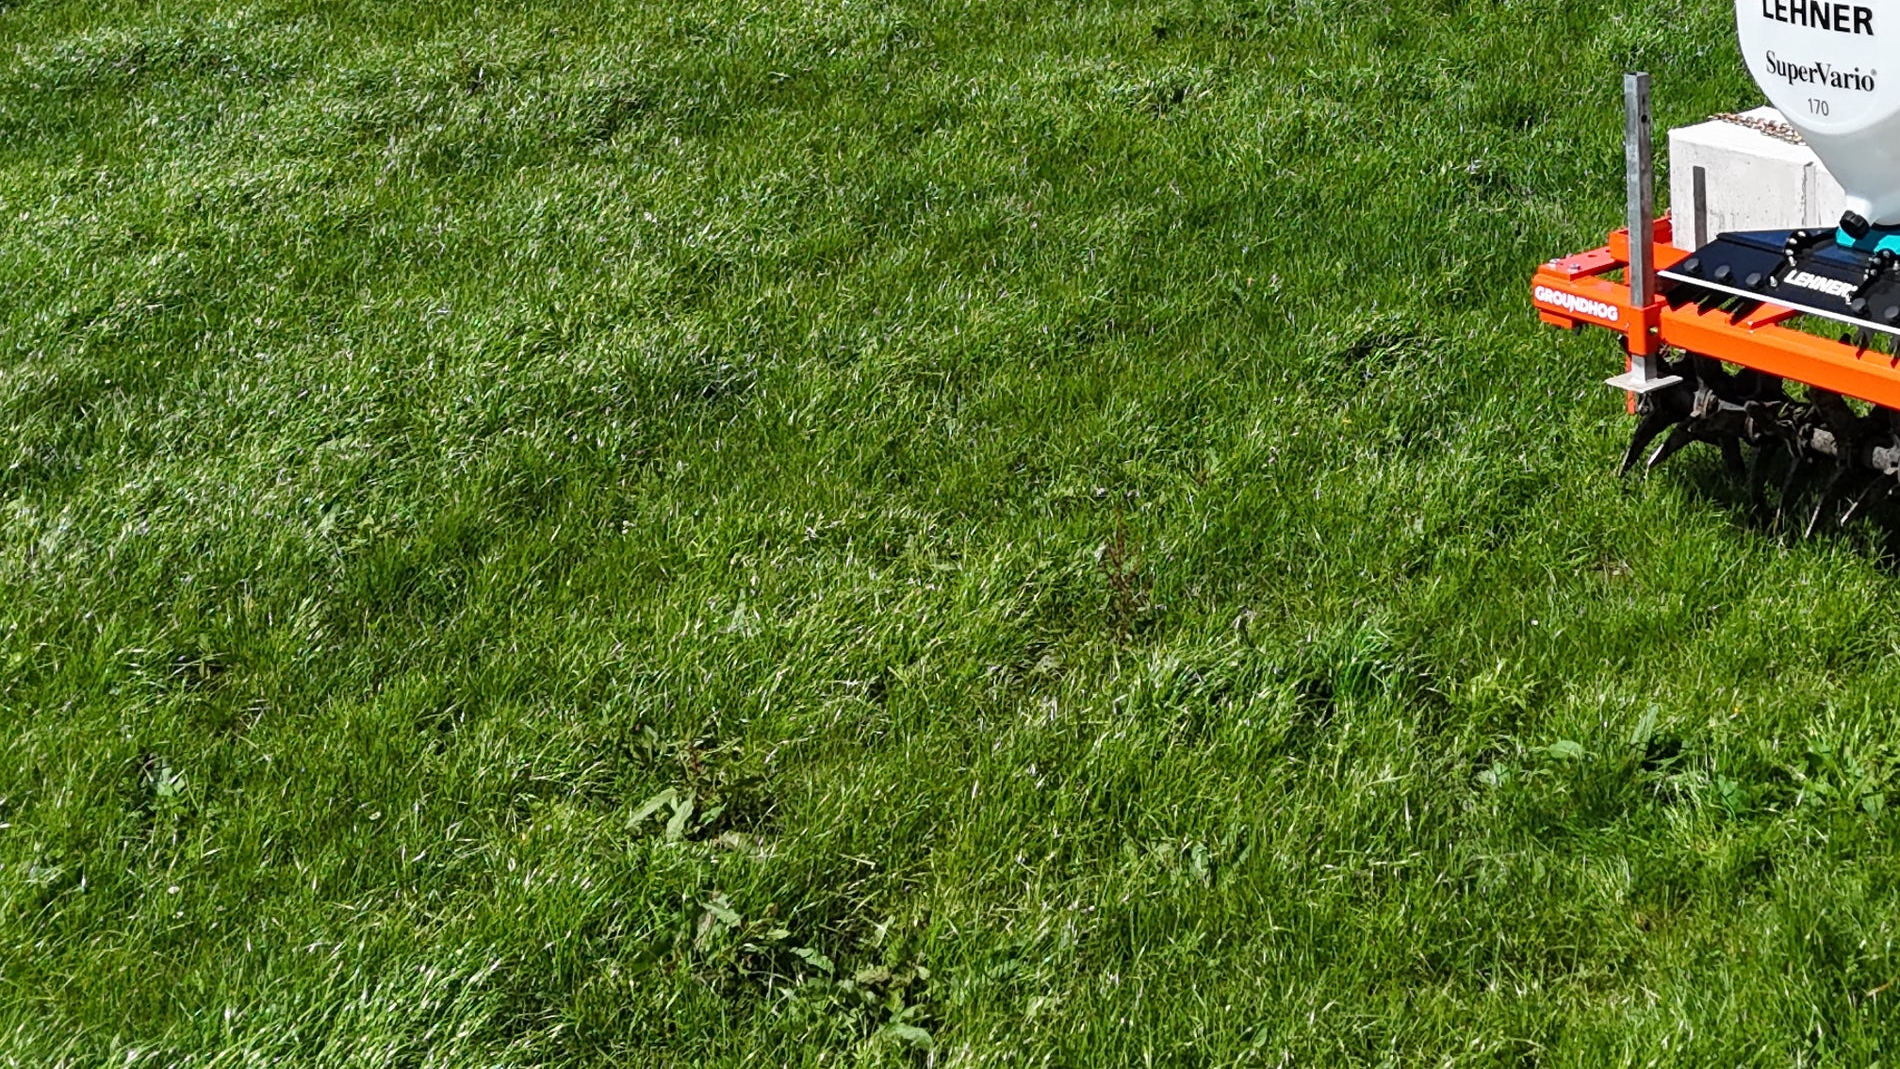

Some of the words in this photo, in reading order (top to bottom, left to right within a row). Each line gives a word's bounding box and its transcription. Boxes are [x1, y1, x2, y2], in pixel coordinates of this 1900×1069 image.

[1808, 97, 1829, 117] 170
[1783, 268, 1858, 298] LEHNER
[1534, 285, 1618, 322] GROUNDHOG
